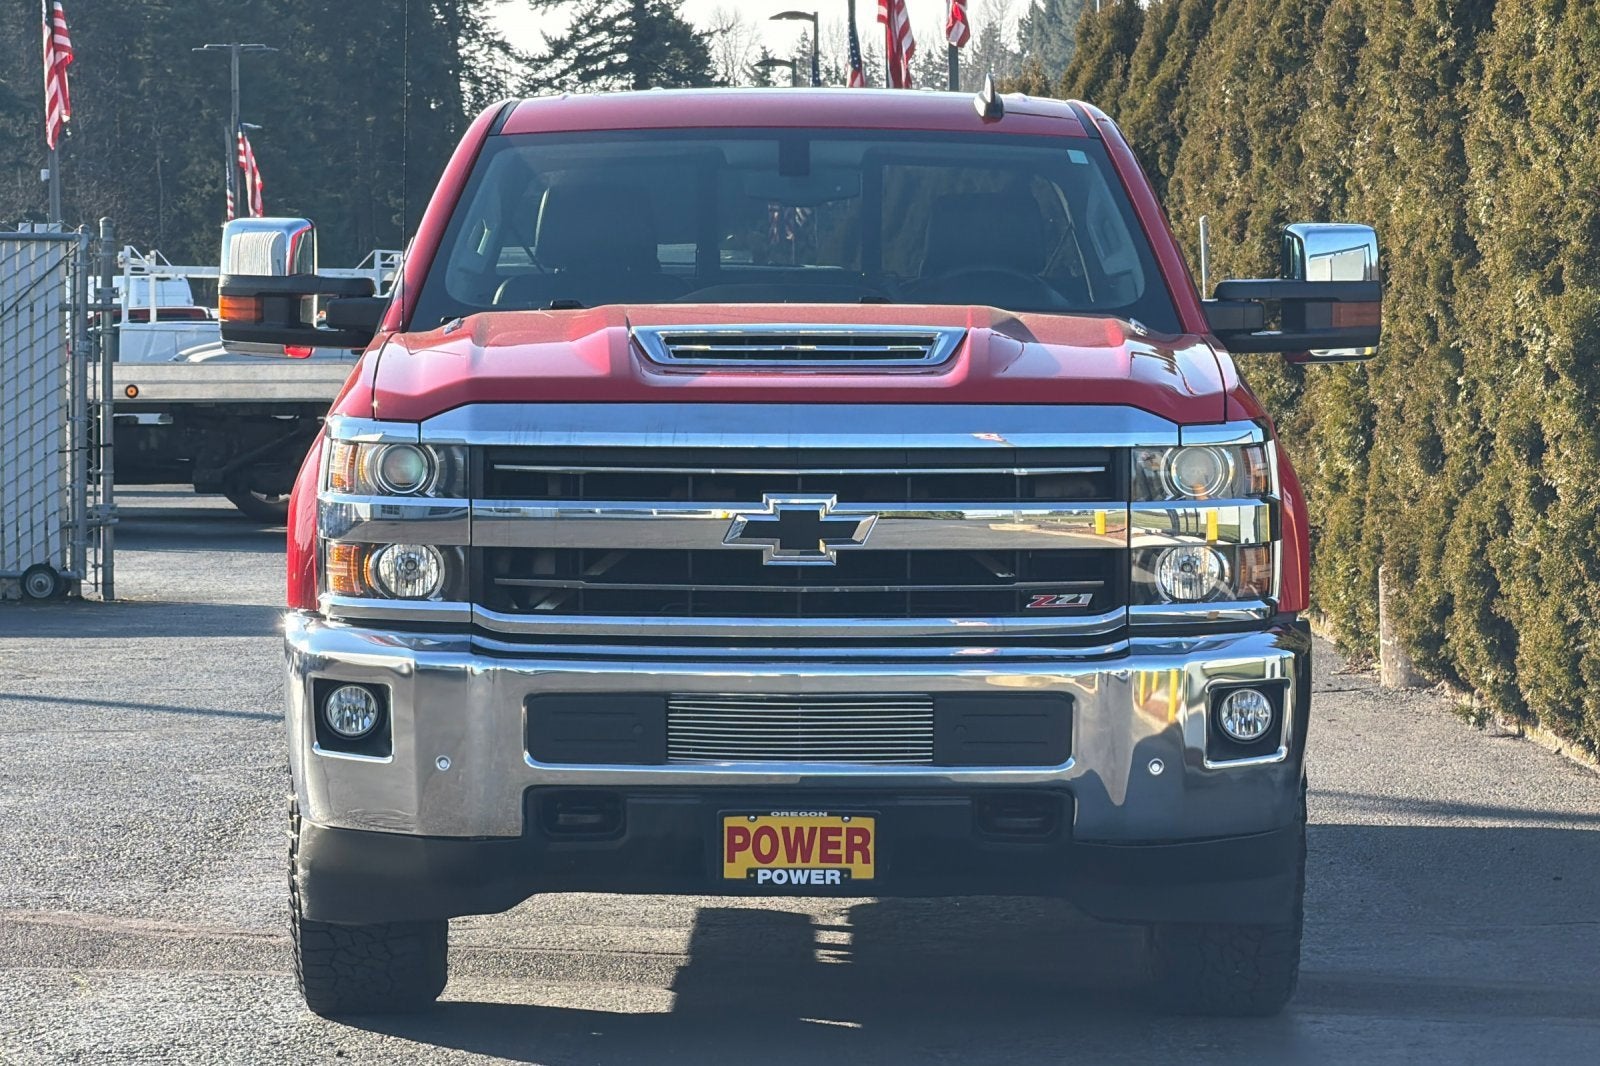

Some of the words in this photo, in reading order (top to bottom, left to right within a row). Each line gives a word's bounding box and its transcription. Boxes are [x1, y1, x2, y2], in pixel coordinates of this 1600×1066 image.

[1026, 593, 1093, 608] Z71
[726, 825, 871, 864] POWER
[757, 869, 841, 885] POWER
